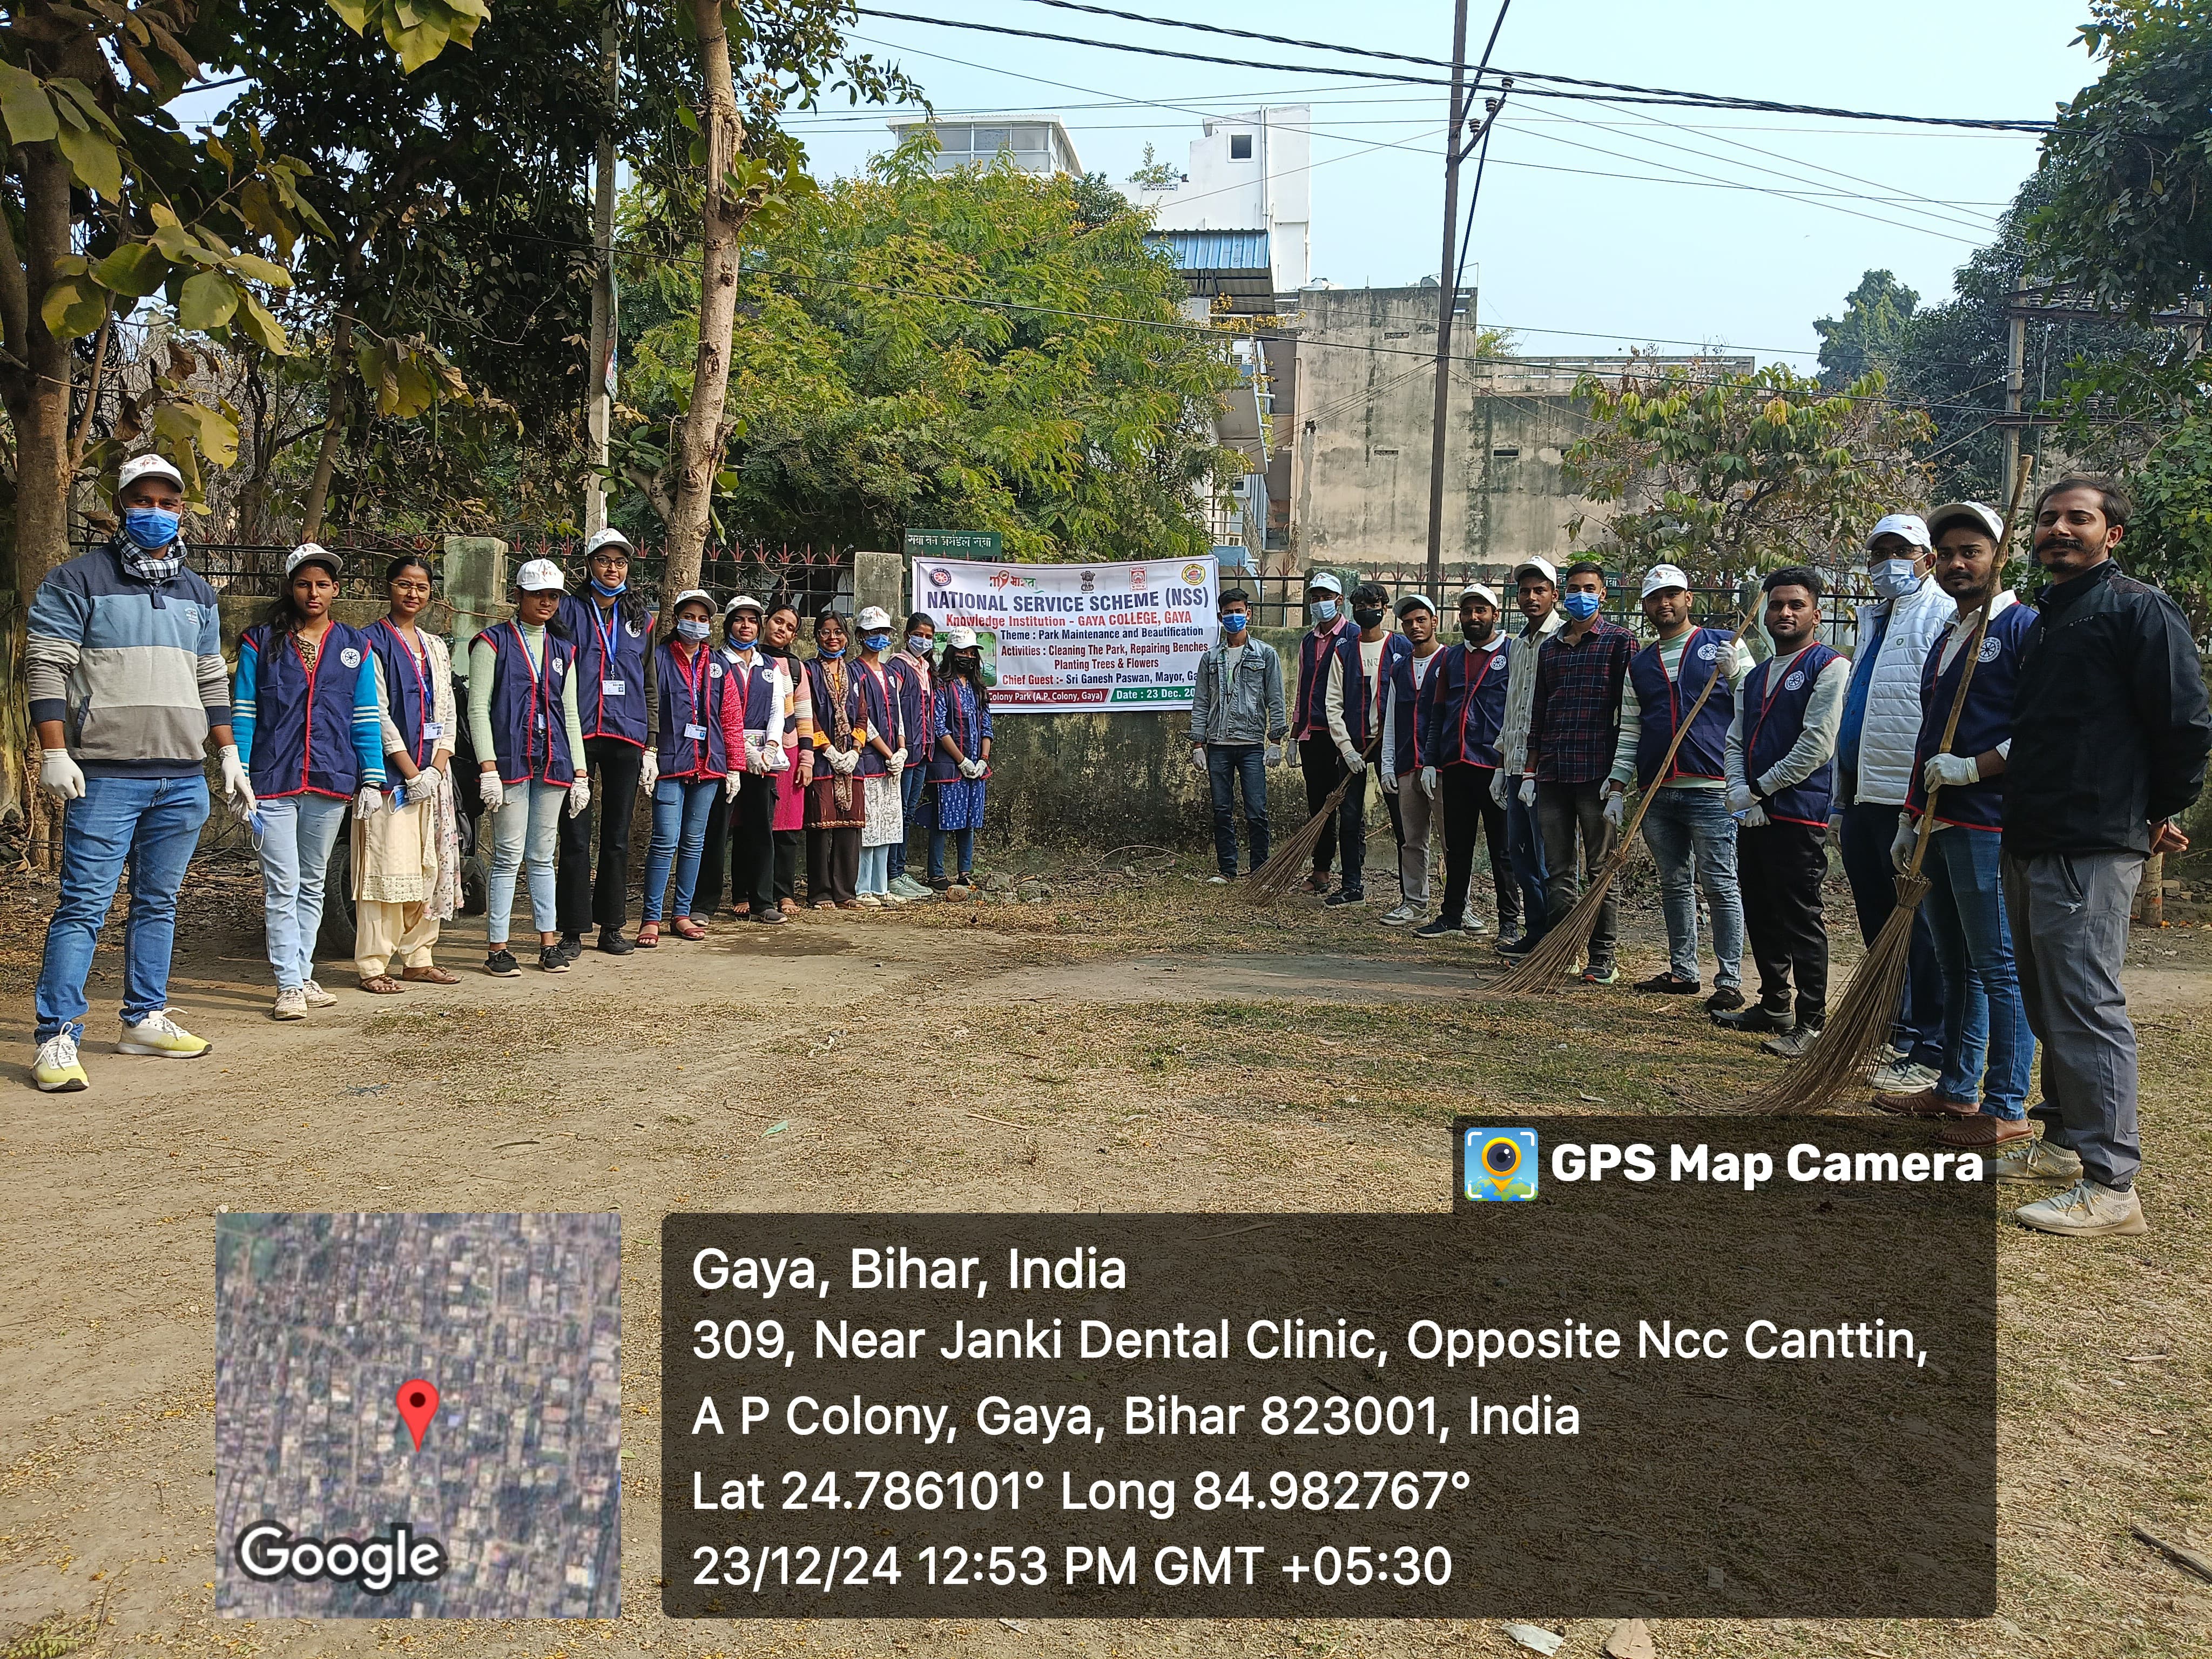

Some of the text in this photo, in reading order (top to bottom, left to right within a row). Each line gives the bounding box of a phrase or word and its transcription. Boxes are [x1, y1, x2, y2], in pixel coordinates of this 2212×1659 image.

[927, 586, 1209, 612] NATIONAL SERVICE SCHEME (NSS)
[946, 614, 1005, 629] Knowledge
[1009, 616, 1065, 626] Institution
[1078, 616, 1106, 626] GAYA
[1109, 611, 1161, 626] COLLEGE,
[1164, 611, 1192, 624] GAYA
[1001, 630, 1030, 640] Theme
[1038, 629, 1059, 639] Park
[1062, 628, 1120, 639] Maintenance
[1122, 628, 1138, 638] and
[1142, 626, 1203, 638] Beautification
[1001, 645, 1041, 656] Activities
[1048, 644, 1085, 657] Cleaning
[1088, 644, 1103, 655] The
[1106, 643, 1128, 656] Park,
[1130, 643, 1170, 655] Repairing
[1054, 658, 1159, 671] Planting Trees & Flowers
[1002, 675, 1026, 685] Chief
[1028, 675, 1054, 685] Guest
[1066, 674, 1078, 684] Sri
[1081, 673, 1113, 684] Ganesh
[1116, 672, 1152, 684] Paswan,
[1155, 672, 1184, 683] Mayor,
[1188, 671, 1198, 681] Ga
[1015, 692, 1031, 700] Park
[1033, 692, 1050, 702] (A.P.
[1051, 692, 1080, 702] Colony,
[1081, 691, 1103, 701] Gaya)
[1116, 690, 1137, 699] Date
[1147, 690, 1158, 698] 23
[1161, 689, 1182, 698] Dec.
[1184, 688, 1195, 697] 20
